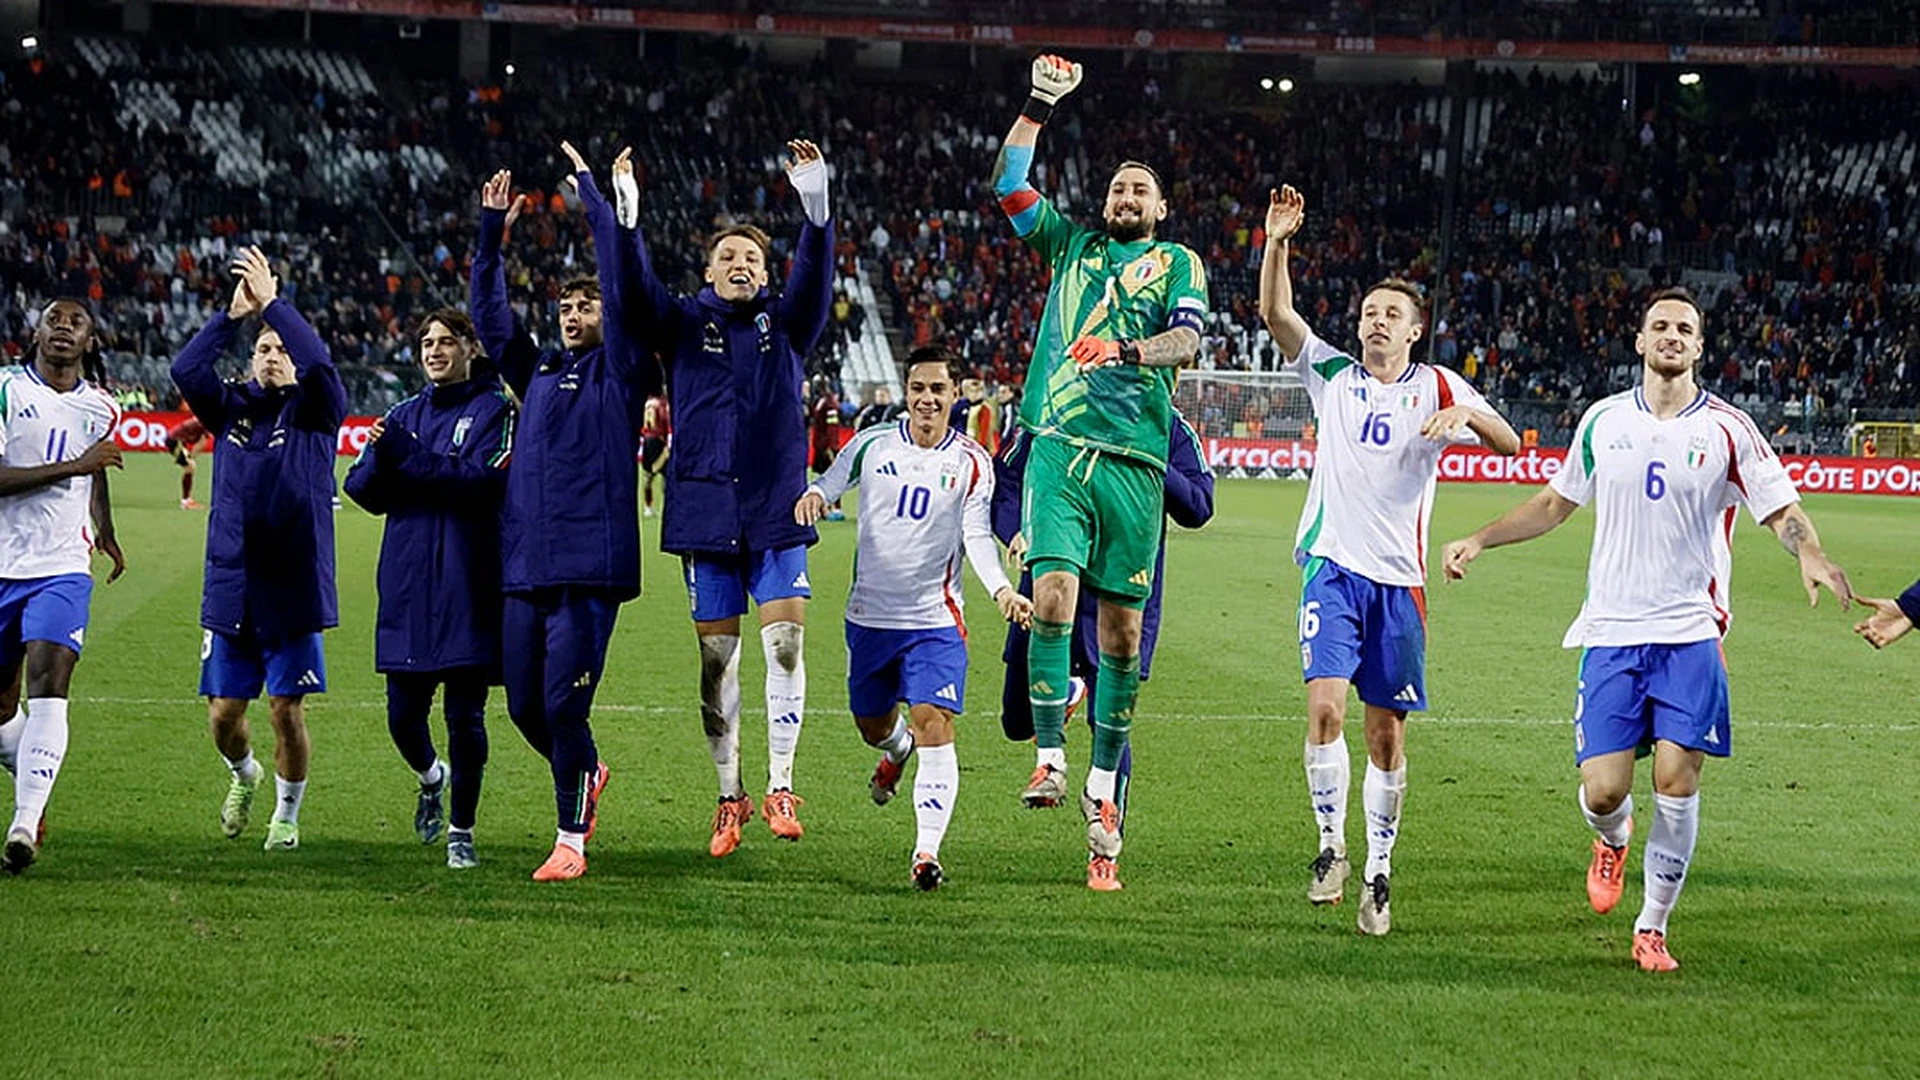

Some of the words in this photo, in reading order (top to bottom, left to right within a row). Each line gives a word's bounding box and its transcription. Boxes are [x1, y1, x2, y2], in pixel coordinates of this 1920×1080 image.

[45, 428, 67, 462] 11
[1360, 411, 1392, 446] 16
[1209, 439, 1316, 469] krach
[1436, 449, 1562, 480] arakte
[1645, 460, 1666, 501] 6
[1784, 460, 1855, 490] CÔTE
[896, 484, 931, 521] 10
